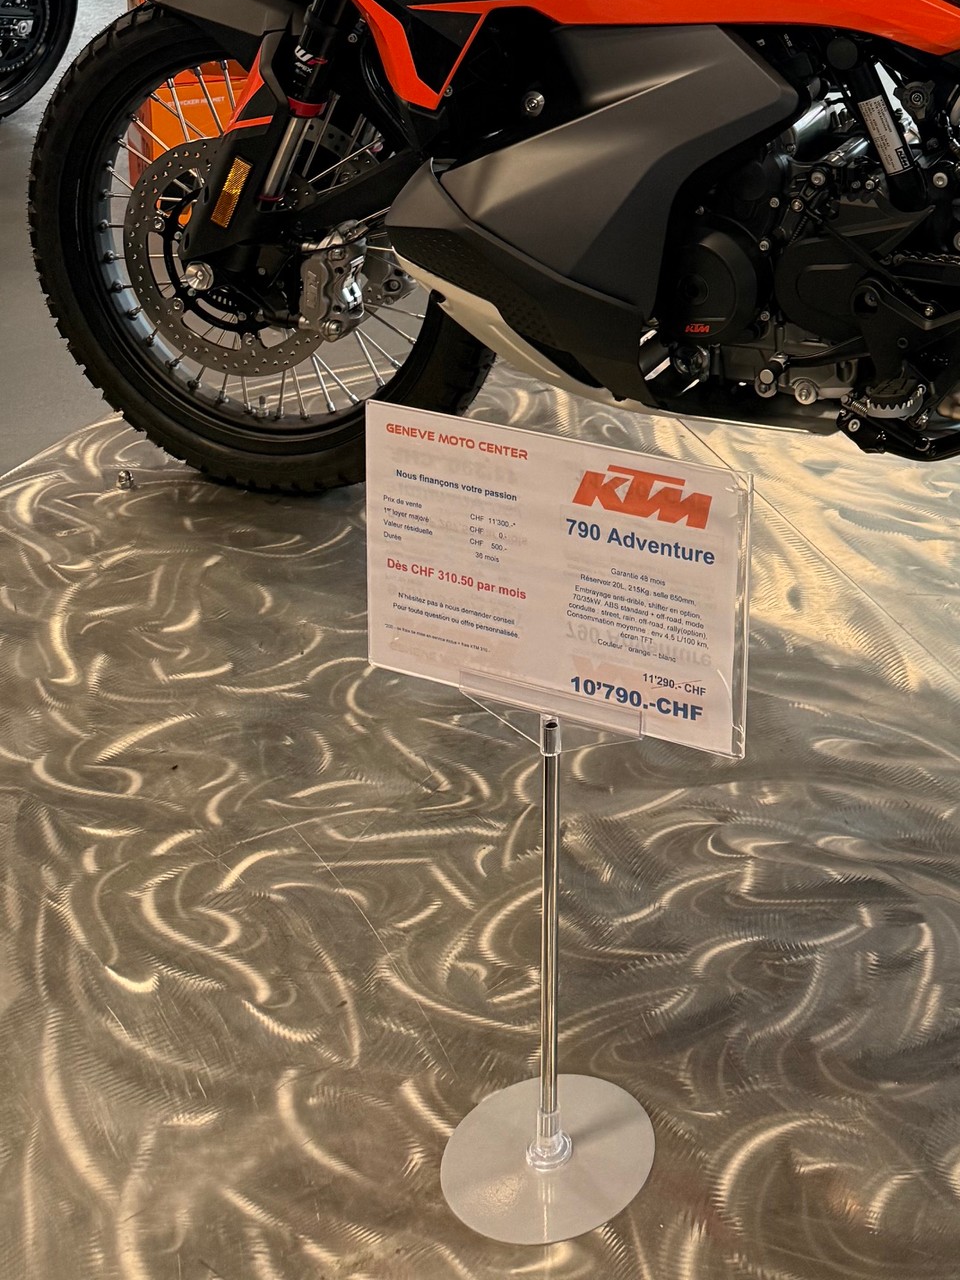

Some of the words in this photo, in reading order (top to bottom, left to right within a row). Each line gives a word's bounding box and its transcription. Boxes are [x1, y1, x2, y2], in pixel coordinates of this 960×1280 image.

[685, 323, 710, 333] KTM
[386, 423, 435, 442] GENEVE
[438, 434, 475, 449] MOTO
[478, 442, 528, 460] CENTER
[396, 469, 417, 481] Nous
[419, 473, 459, 490] finançons
[461, 483, 483, 494] votre
[484, 488, 517, 502] passion
[572, 464, 713, 530] KTM
[470, 513, 484, 522] CHF
[469, 526, 484, 535] CHF
[469, 538, 484, 547] CHF
[491, 542, 507, 552] 500.-
[566, 518, 601, 541] 790
[607, 527, 715, 565] Adventure
[484, 554, 500, 563] mois
[387, 558, 408, 572] Dès
[411, 563, 435, 578] CHF
[438, 570, 474, 587] 310.50
[476, 580, 496, 592] par
[499, 585, 527, 600] mois
[580, 573, 611, 587] Réservoir
[610, 567, 639, 580] Garantie
[650, 577, 666, 586] mois
[574, 584, 612, 599] Embrayage
[444, 603, 460, 612] nous
[461, 607, 492, 620] demander
[603, 600, 619, 610] ABS
[685, 619, 704, 630] mode
[566, 609, 615, 627] Consommation
[616, 622, 646, 634] moyenne
[628, 645, 651, 657] orange
[684, 683, 707, 697] CHF
